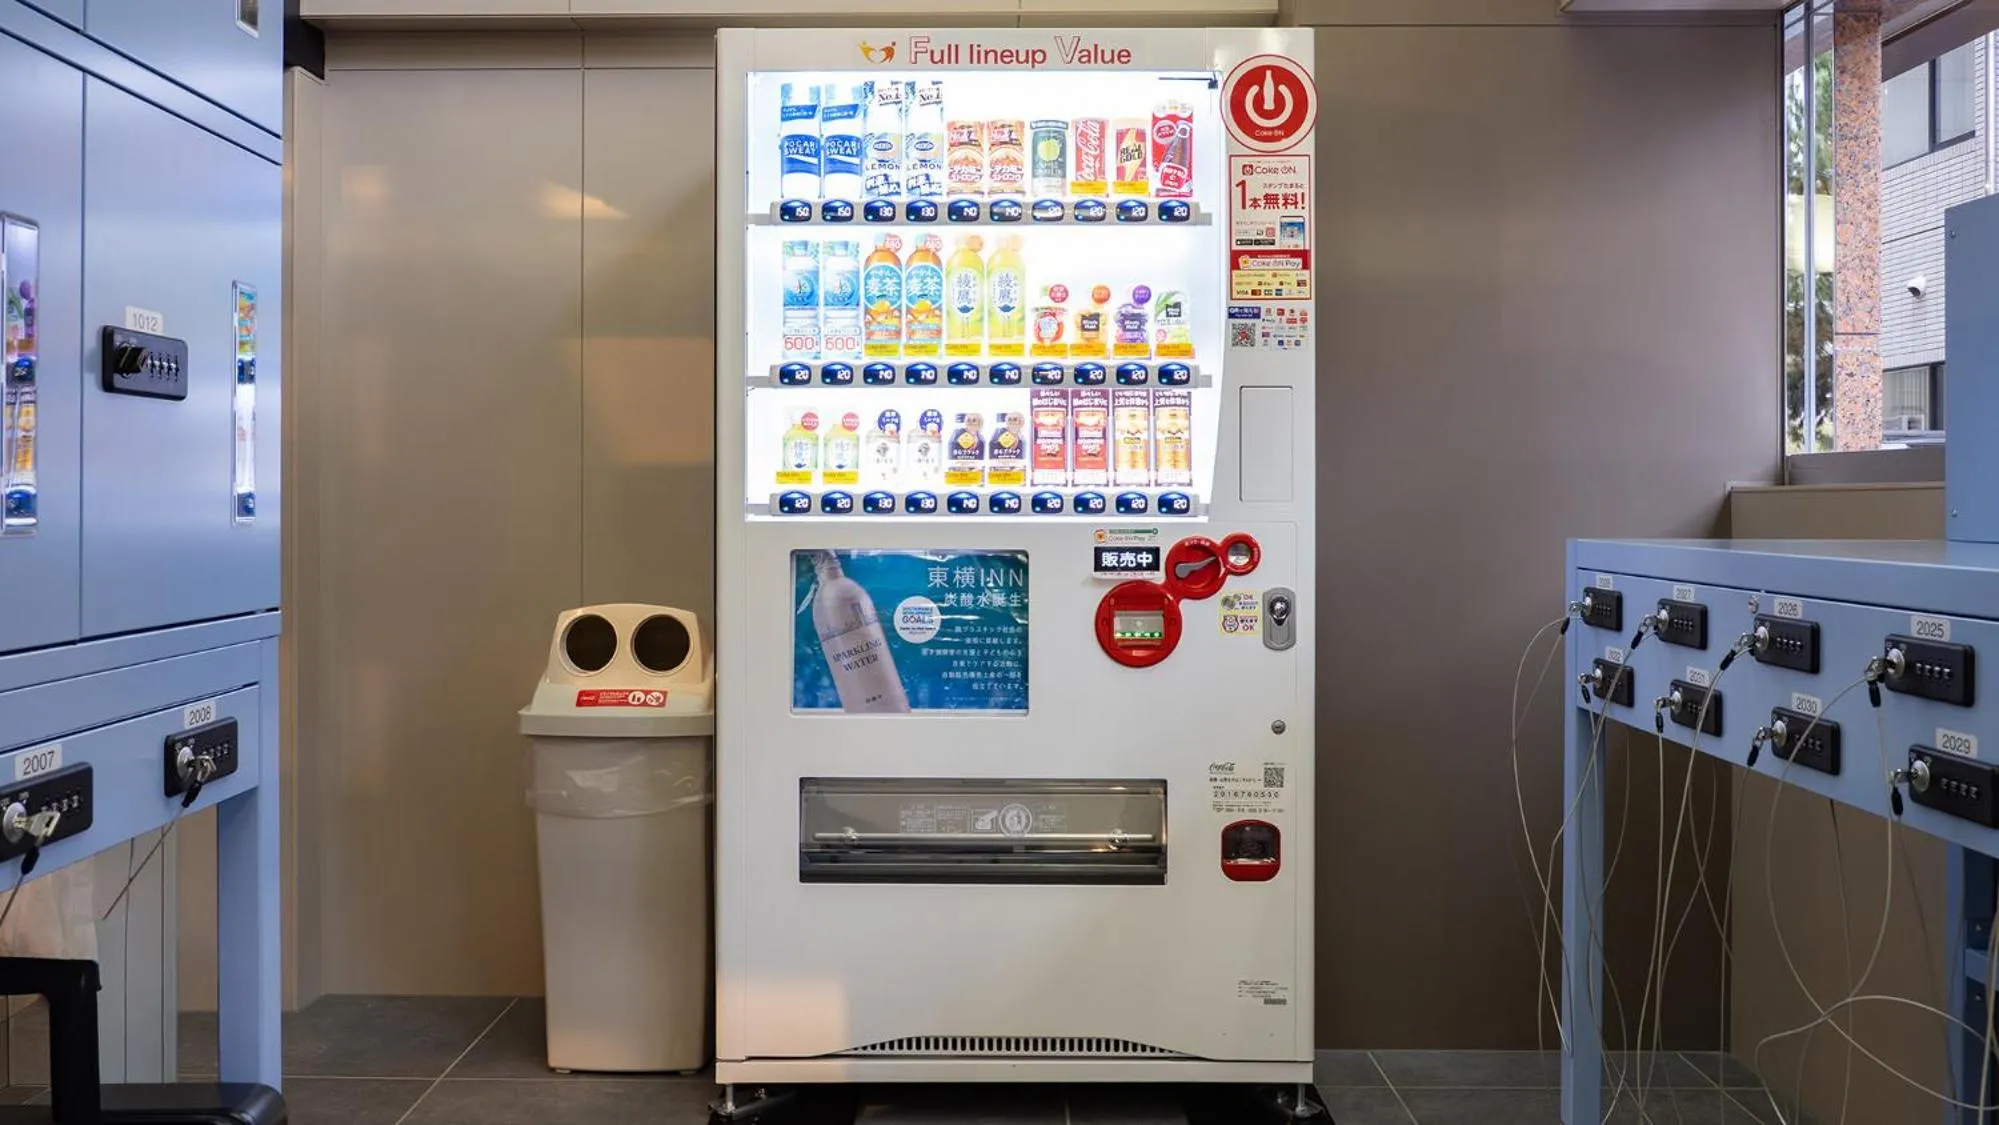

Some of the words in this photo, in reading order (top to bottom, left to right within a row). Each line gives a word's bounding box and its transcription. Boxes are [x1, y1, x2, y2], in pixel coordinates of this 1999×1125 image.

[909, 35, 959, 65] Full
[968, 44, 1047, 68] lineup
[1054, 35, 1132, 65] Value
[784, 148, 816, 156] SWEAT
[826, 148, 858, 156] SWEAT
[1254, 166, 1279, 174] Coke
[132, 312, 159, 332] 1012
[784, 337, 814, 350] 600
[825, 337, 856, 350] 600
[1102, 552, 1152, 567] 販売中
[927, 566, 1023, 588] 東横INN
[1916, 621, 1944, 638] 2025
[832, 639, 882, 662] SPARKLING
[844, 654, 878, 672] WATER
[1796, 697, 1817, 713] 2030
[189, 706, 211, 725] 2008
[1942, 734, 1971, 754] 2029
[23, 752, 55, 775] 2007
